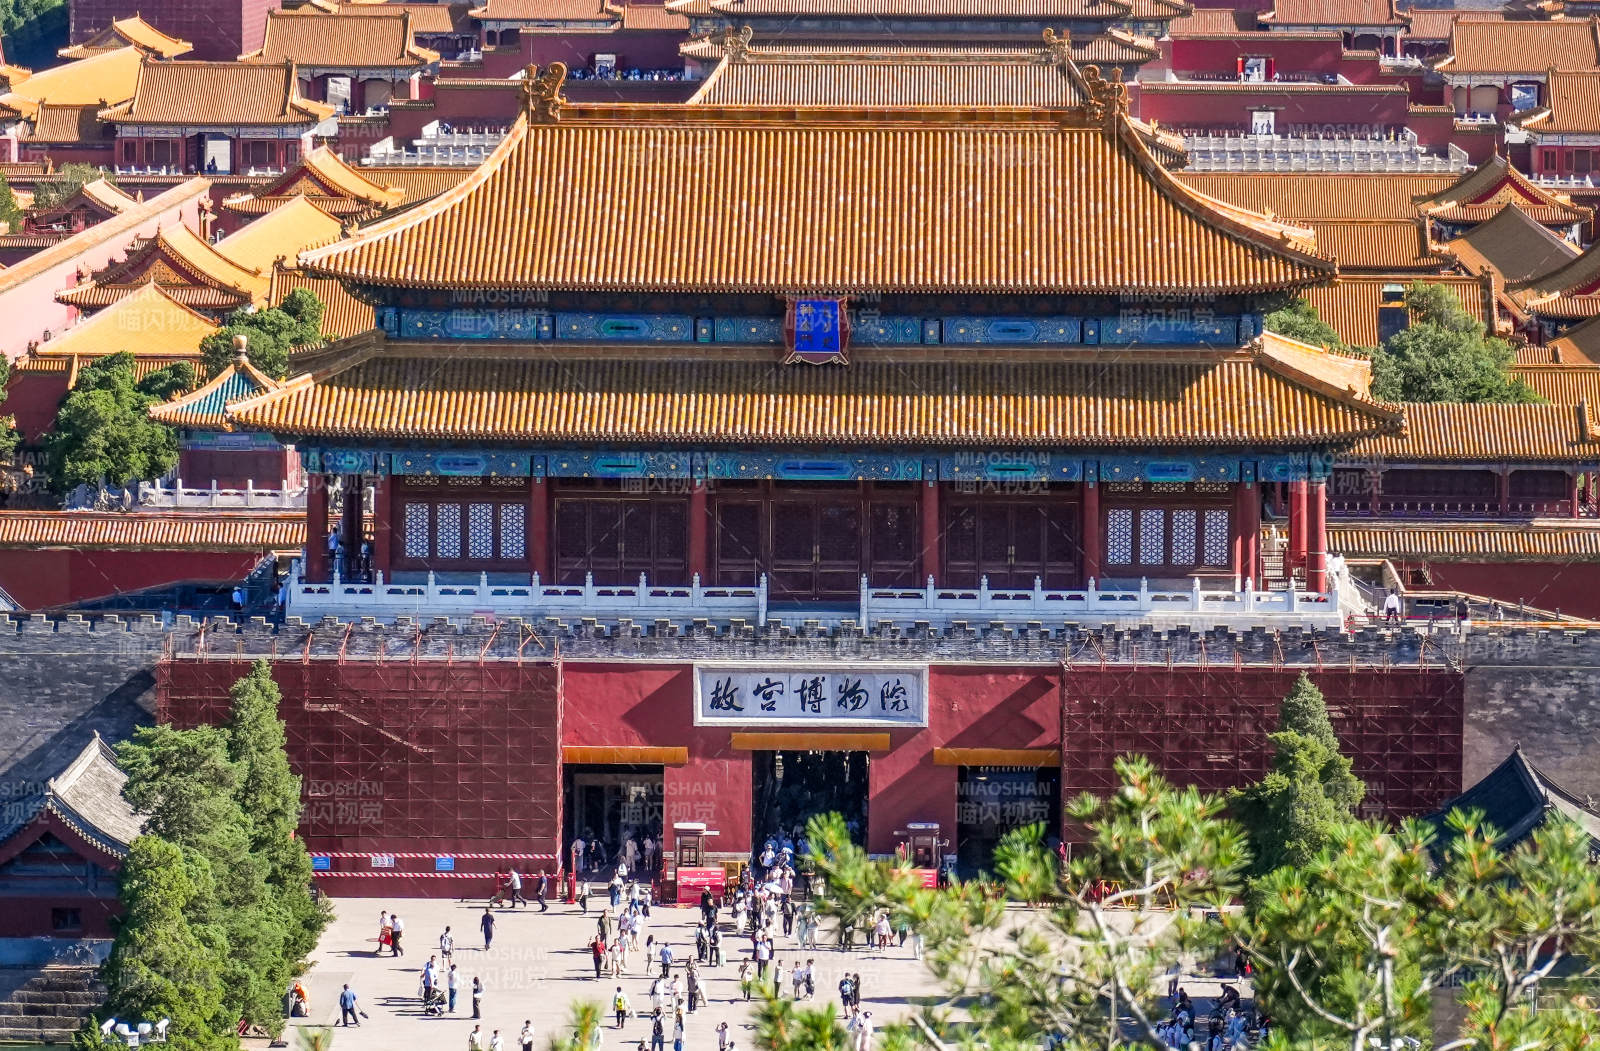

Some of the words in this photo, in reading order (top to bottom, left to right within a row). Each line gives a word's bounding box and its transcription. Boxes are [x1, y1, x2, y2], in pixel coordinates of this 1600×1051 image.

[708, 674, 910, 713] 故宫博物院
